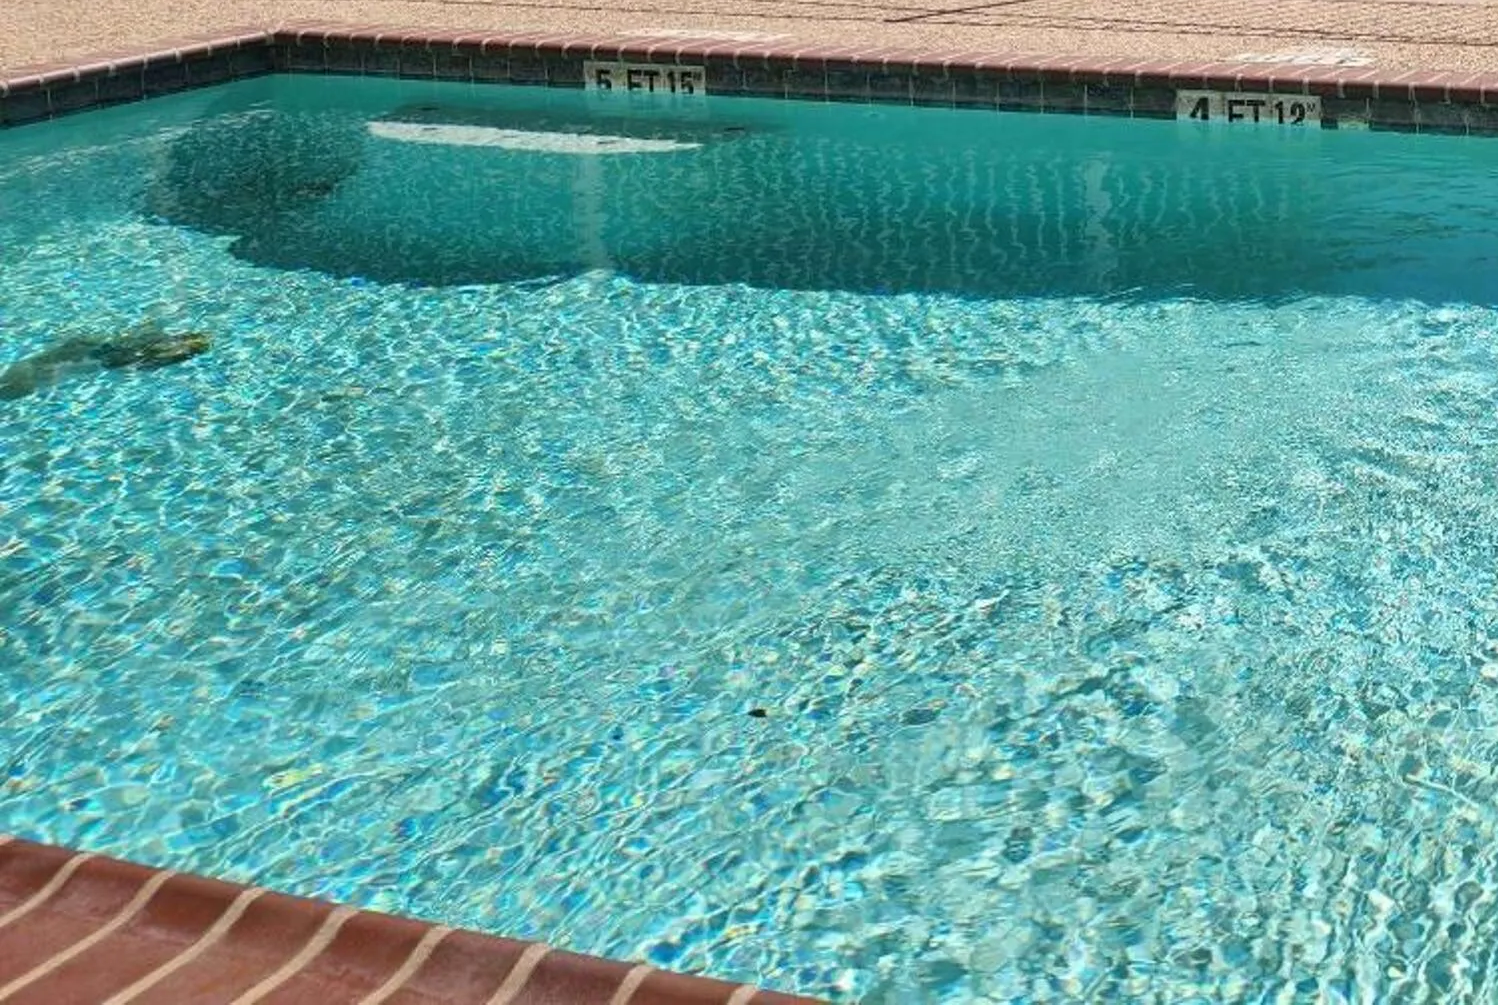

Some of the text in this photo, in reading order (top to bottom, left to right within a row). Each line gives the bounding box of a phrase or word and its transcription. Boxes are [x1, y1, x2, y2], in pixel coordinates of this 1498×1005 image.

[627, 69, 659, 91] FT
[1190, 97, 1209, 120] 4
[1228, 100, 1265, 123] FT
